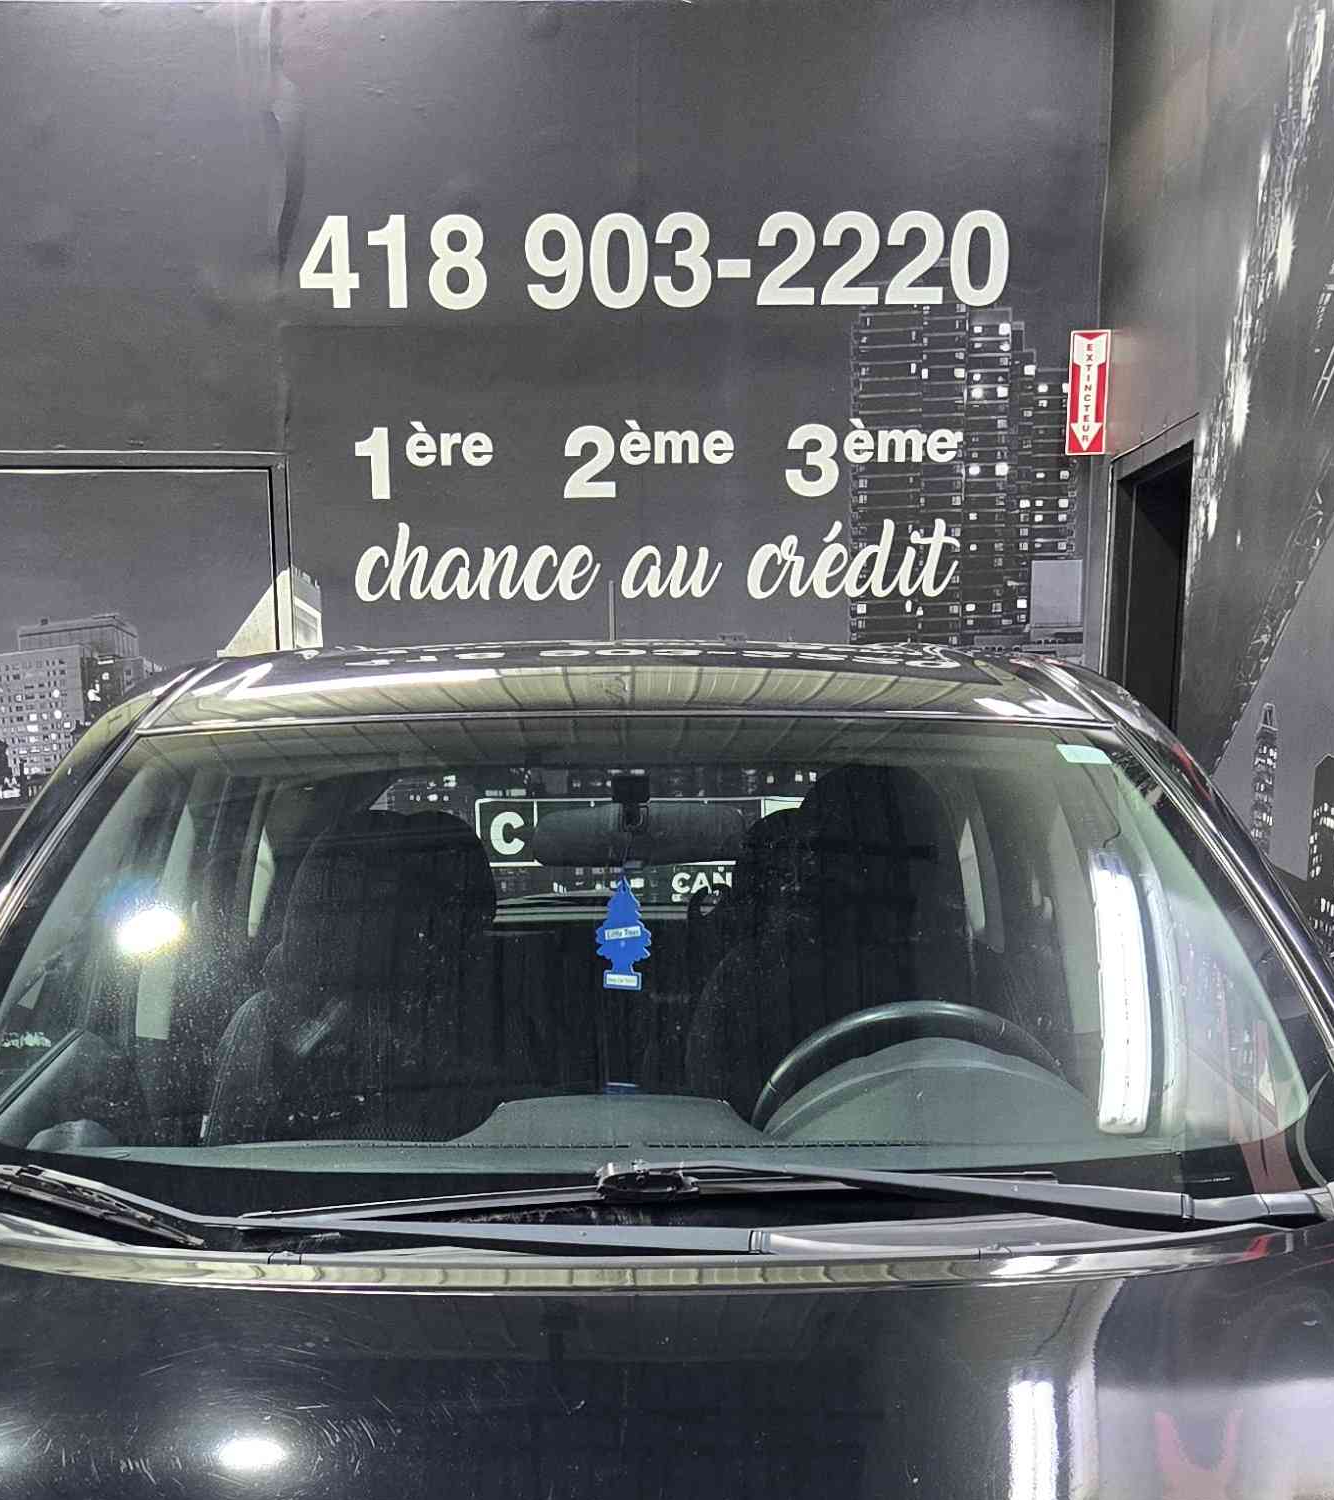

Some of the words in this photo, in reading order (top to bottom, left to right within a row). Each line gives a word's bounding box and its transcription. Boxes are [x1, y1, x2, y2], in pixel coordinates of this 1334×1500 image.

[298, 213, 488, 311] 418
[524, 209, 1009, 310] 903-2220
[1081, 343, 1094, 442] EXTINCTEUR
[354, 421, 494, 500] 1ère
[563, 420, 735, 499] 2ème
[785, 419, 964, 497] 3ème
[354, 522, 601, 602] chance
[620, 545, 723, 599] au
[746, 518, 961, 600] crédit
